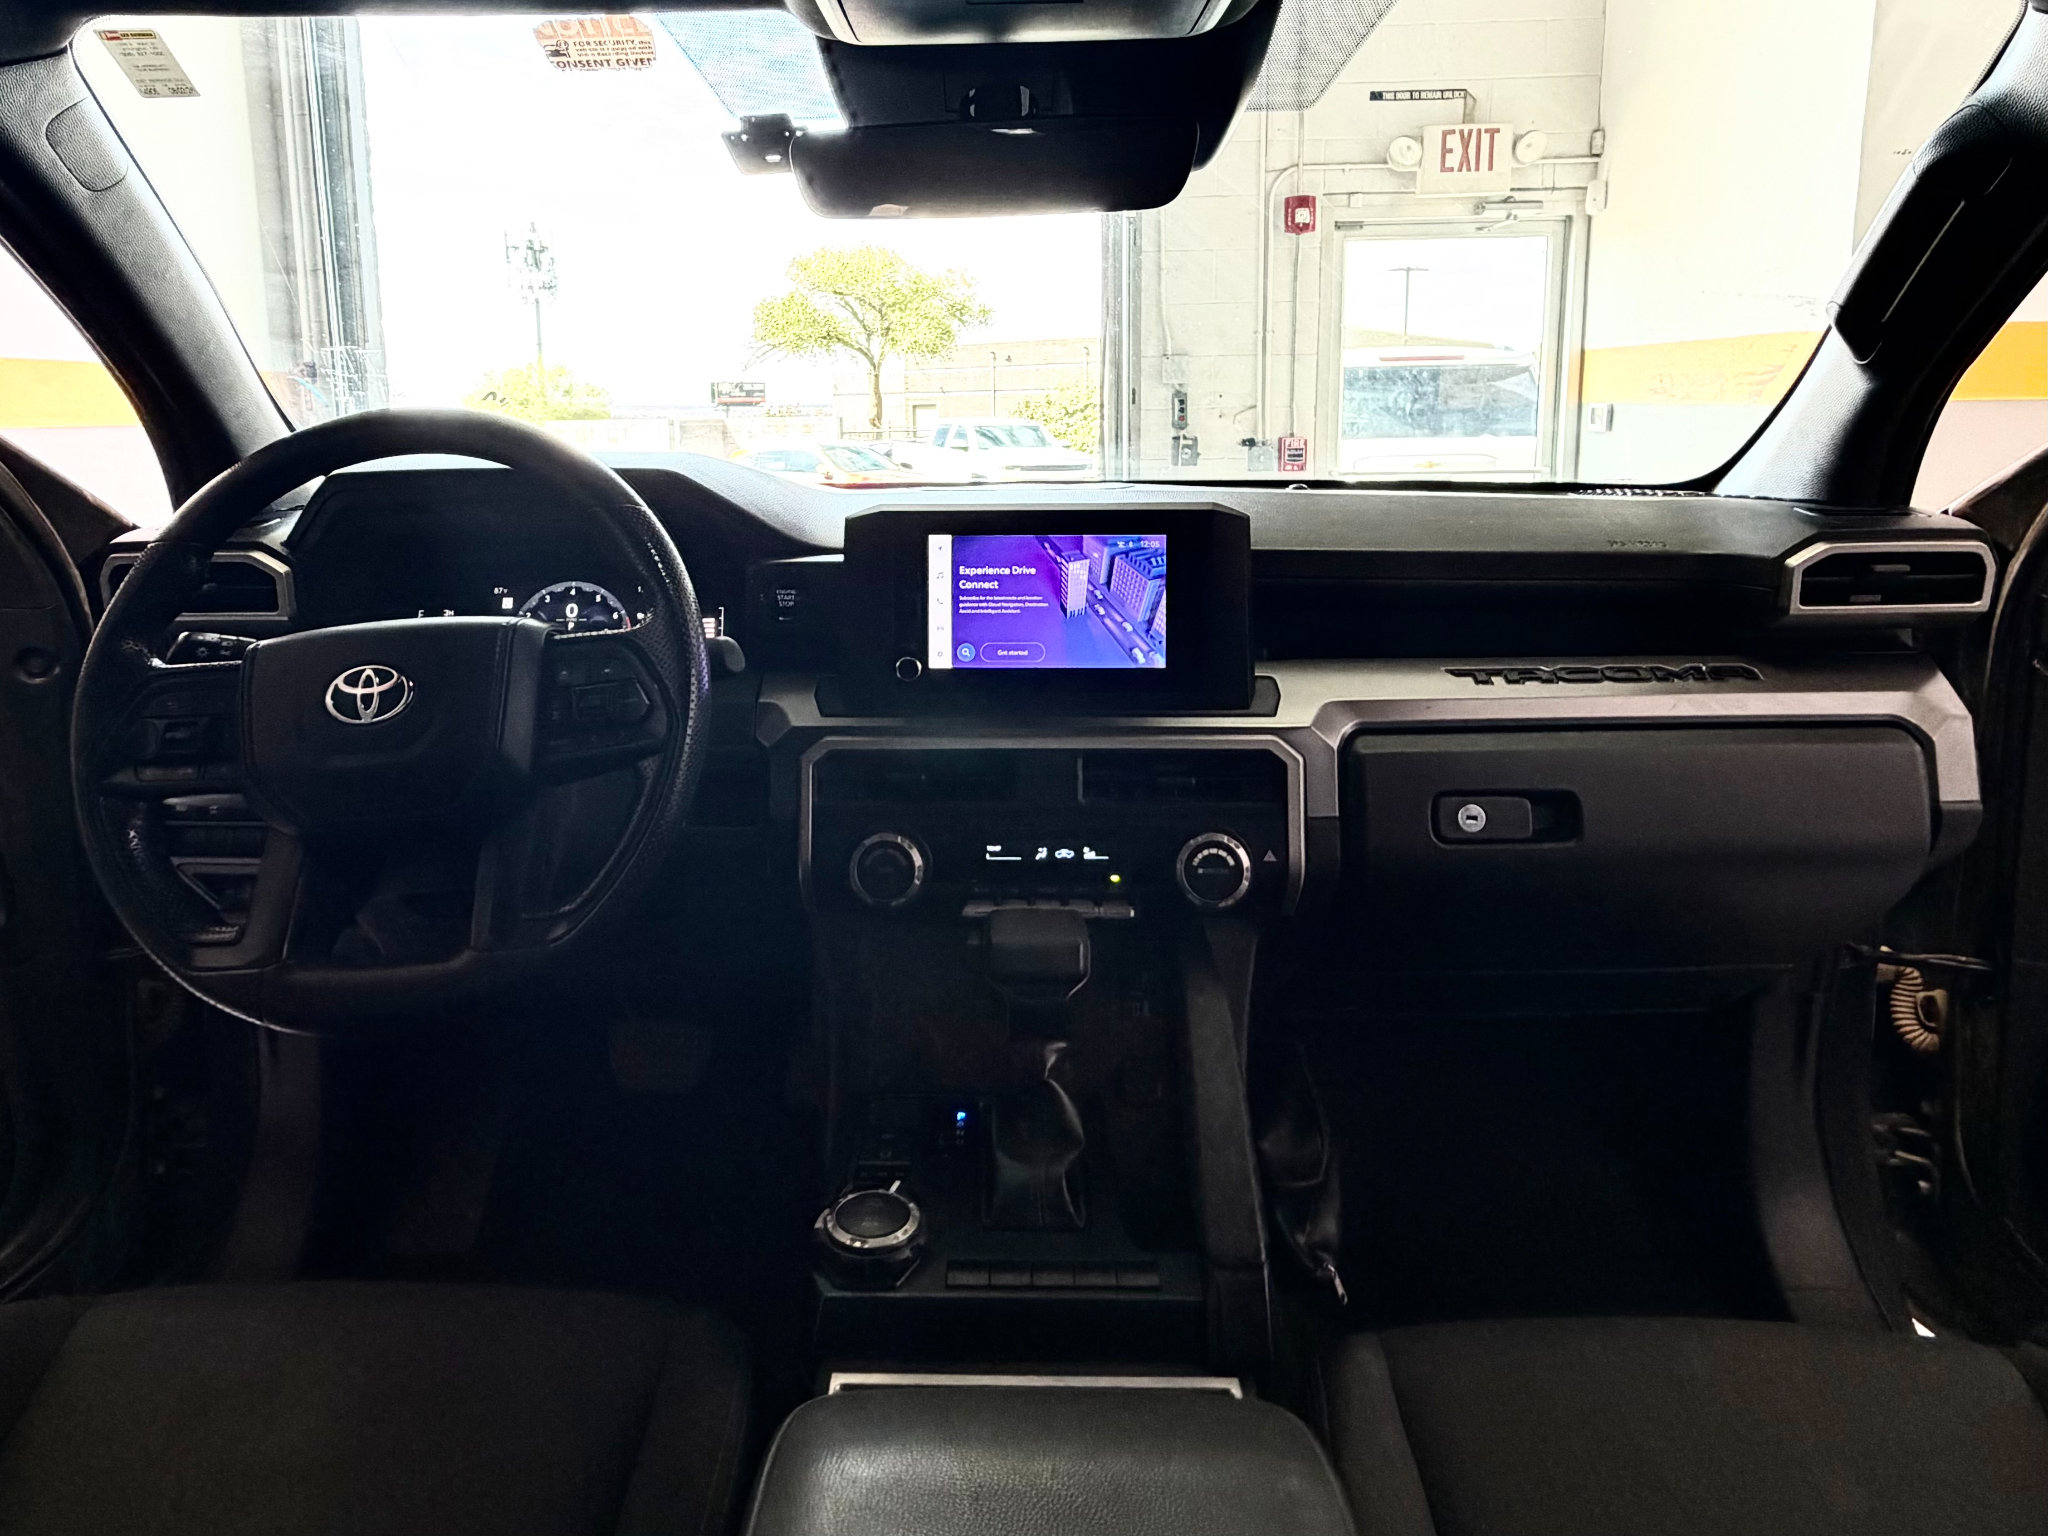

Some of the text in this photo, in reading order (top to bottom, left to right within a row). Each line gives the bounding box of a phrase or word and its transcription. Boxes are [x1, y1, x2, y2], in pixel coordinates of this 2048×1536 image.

[551, 58, 611, 69] ONSENT
[1440, 128, 1500, 172] EXIT
[1286, 438, 1305, 447] FIRE
[1140, 540, 1160, 548] 12:05
[959, 565, 1036, 576] Experience Drive
[958, 579, 999, 589] Connect
[544, 595, 550, 603] 3
[595, 594, 601, 602] 5
[565, 603, 579, 618] 0
[1443, 663, 1764, 686] TACOMA
